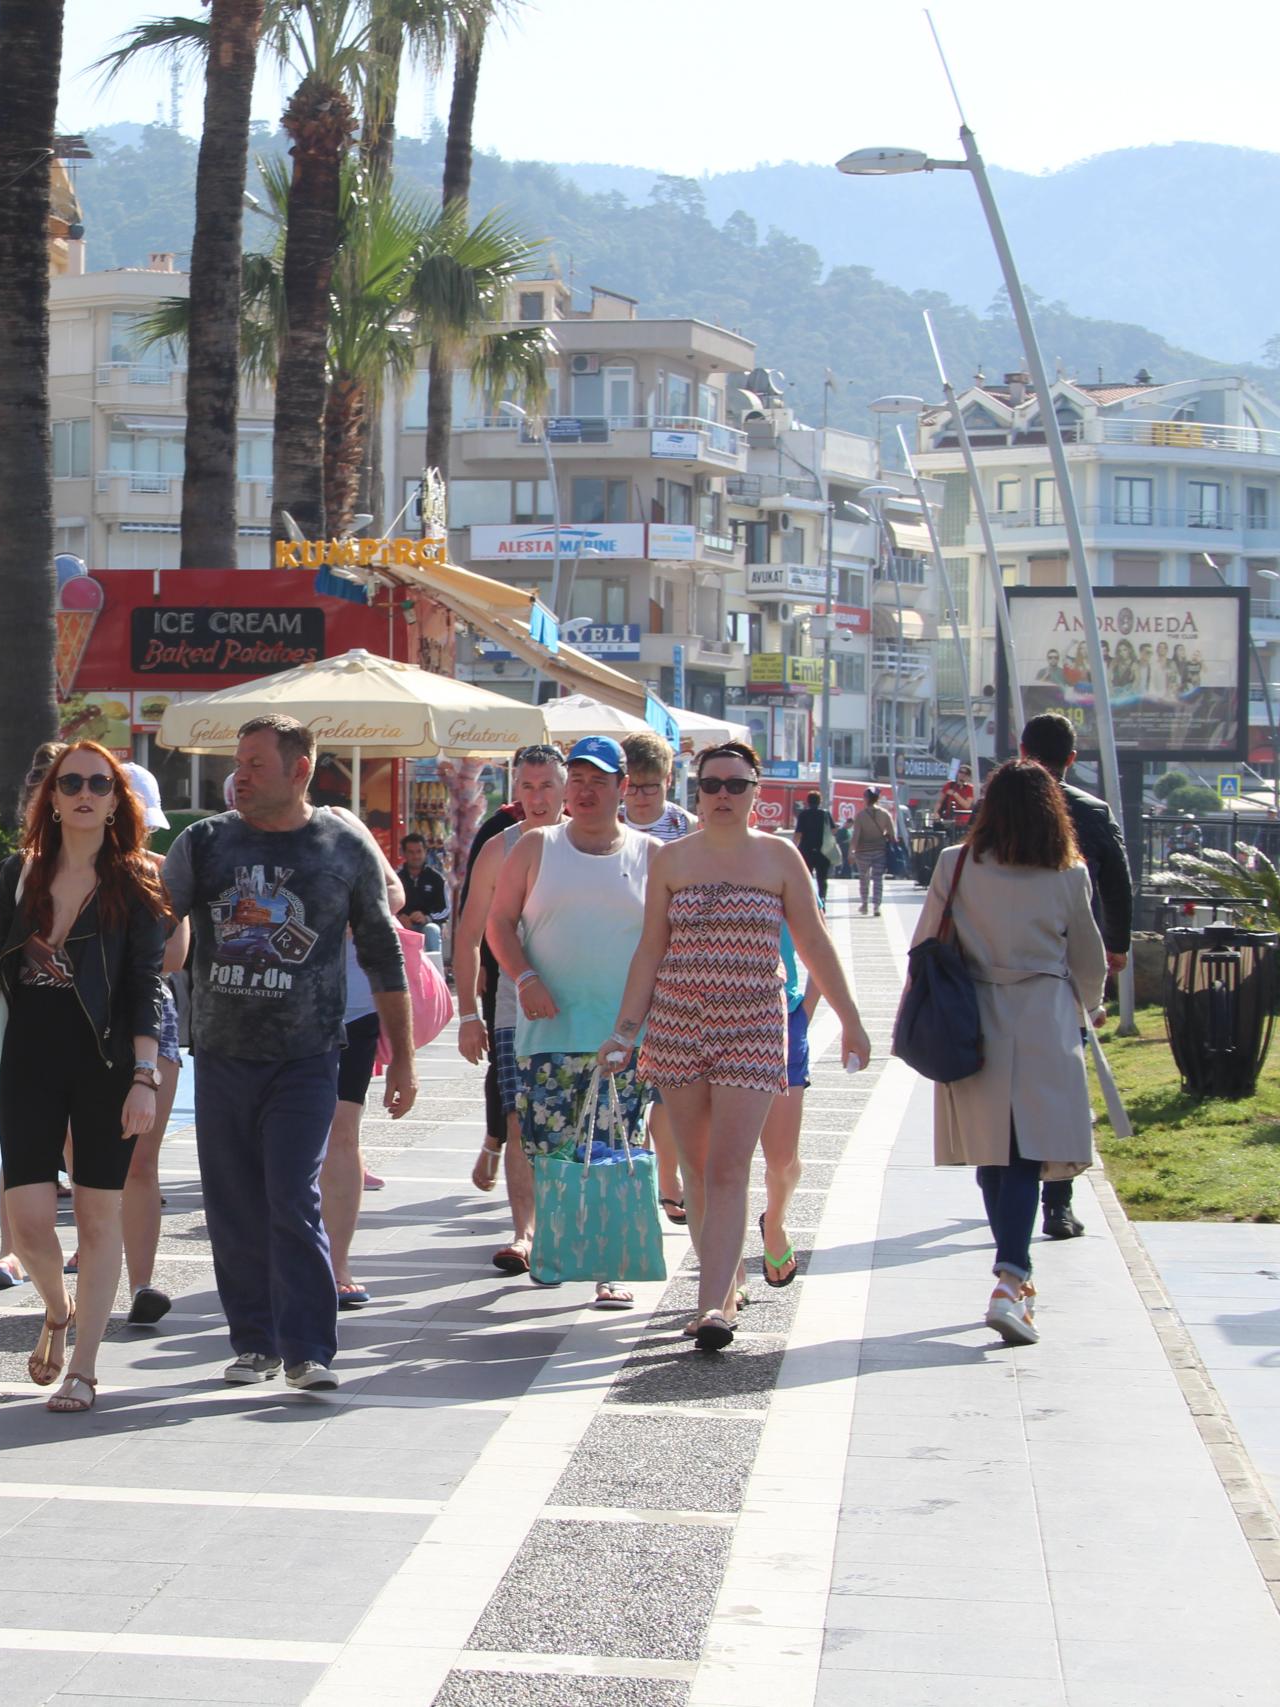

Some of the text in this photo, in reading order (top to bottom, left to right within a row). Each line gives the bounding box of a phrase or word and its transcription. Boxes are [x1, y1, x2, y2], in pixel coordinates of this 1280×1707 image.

[498, 540, 553, 553] ALESTA
[752, 570, 784, 584] AVUKAT
[153, 612, 303, 634] ICE CREAM
[140, 638, 318, 670] Baked Potatoes
[792, 659, 824, 682] Emla
[448, 719, 521, 746] Gelateria
[235, 865, 295, 898] MY
[210, 962, 245, 986] FOR
